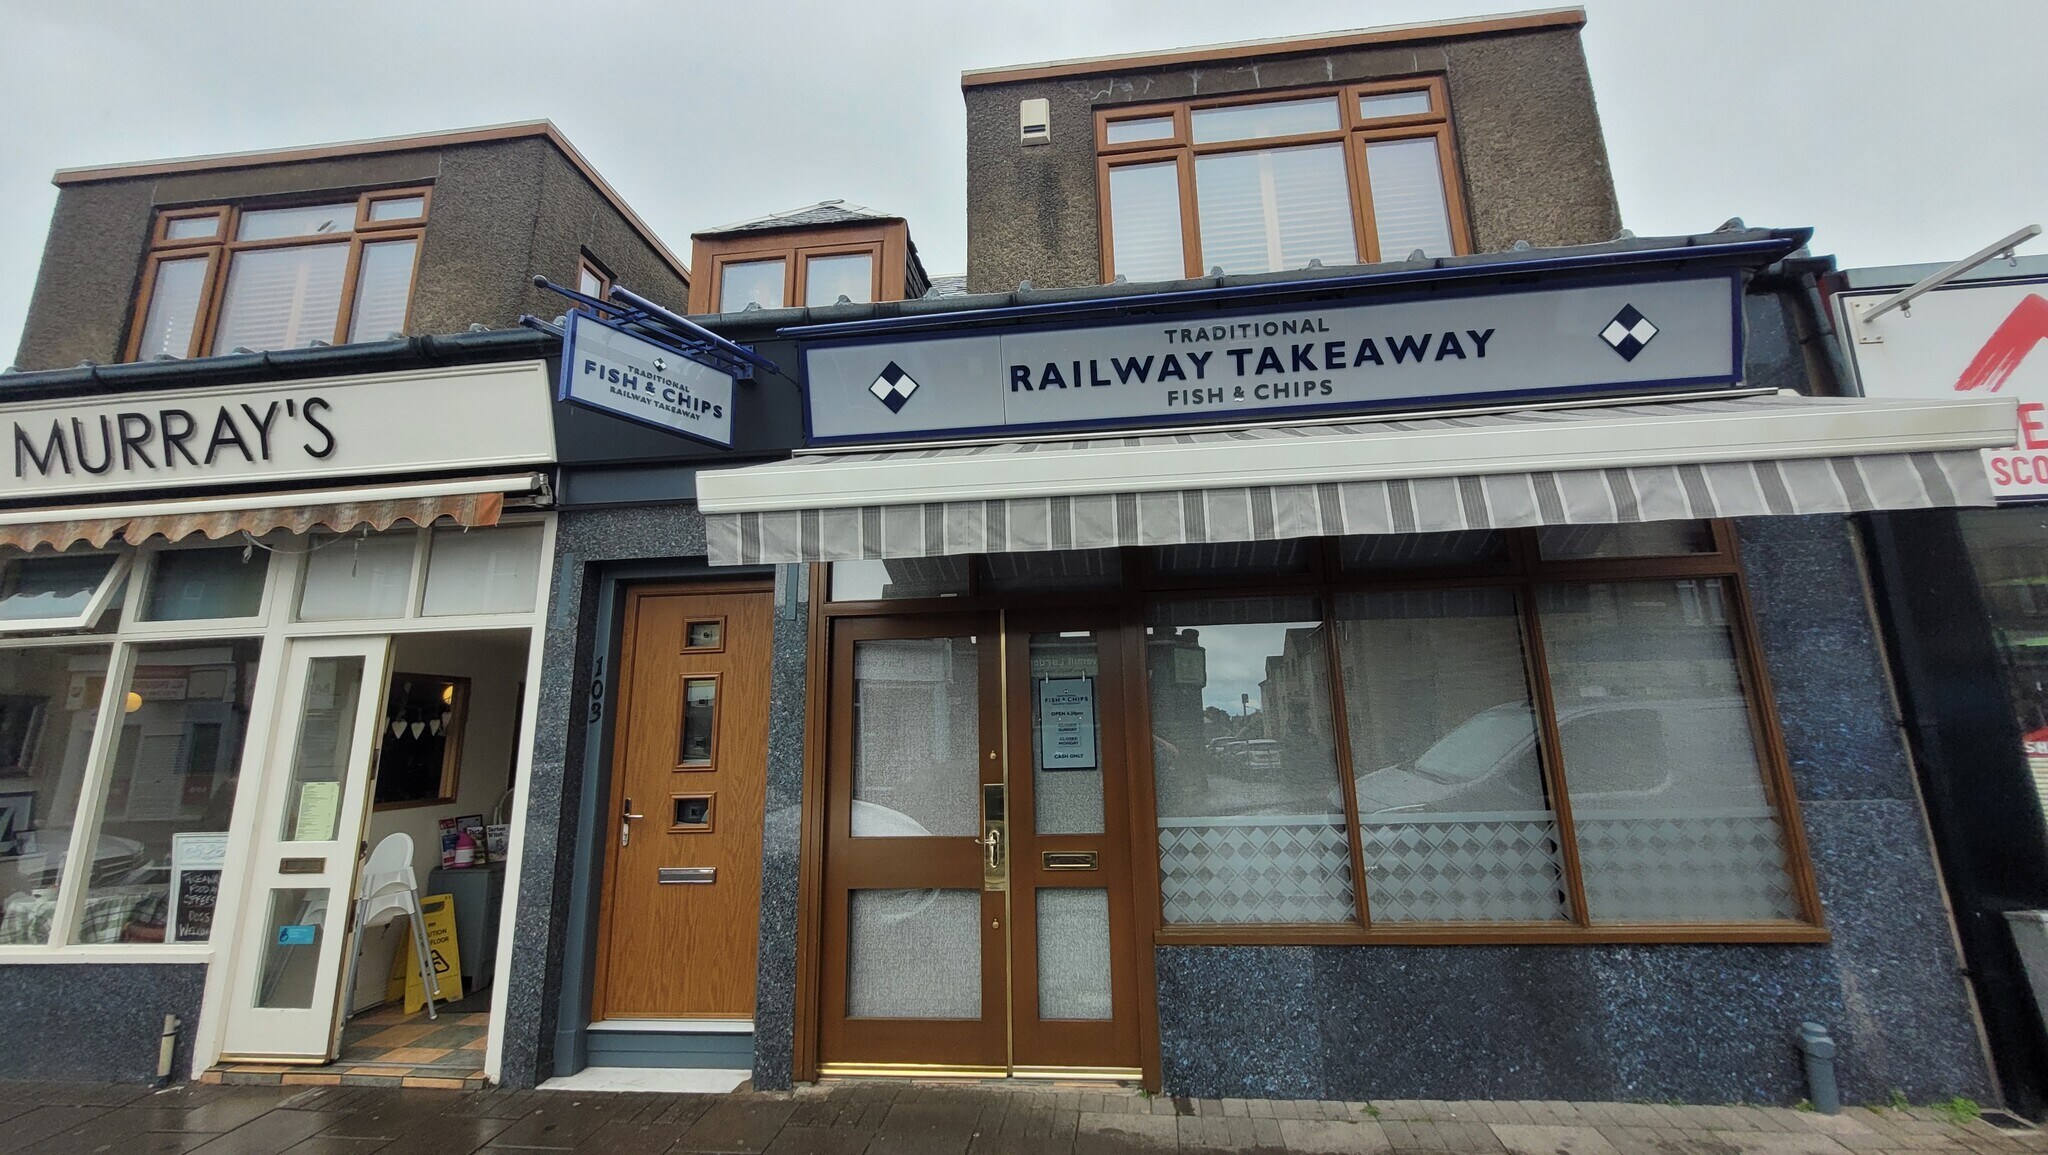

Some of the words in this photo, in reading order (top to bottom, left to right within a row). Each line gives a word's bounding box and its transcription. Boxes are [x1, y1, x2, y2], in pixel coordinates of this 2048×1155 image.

[1164, 317, 1330, 344] TRADITIONAL
[1010, 351, 1213, 392] RAILWAY
[1227, 328, 1496, 377] TAKEAWAY
[584, 359, 638, 391] FISH
[645, 381, 656, 393] &
[662, 388, 723, 419] CHIPS
[627, 365, 690, 393] TRADITIONAL
[1167, 387, 1224, 406] FISH
[1233, 385, 1245, 399] &
[1253, 379, 1333, 401] CHIPS
[610, 385, 652, 406] RAILWAY
[653, 399, 701, 421] TAKEAWAY
[13, 397, 335, 478] MURRAY'S
[588, 655, 604, 724] 103
[430, 936, 450, 945] FLOOR
